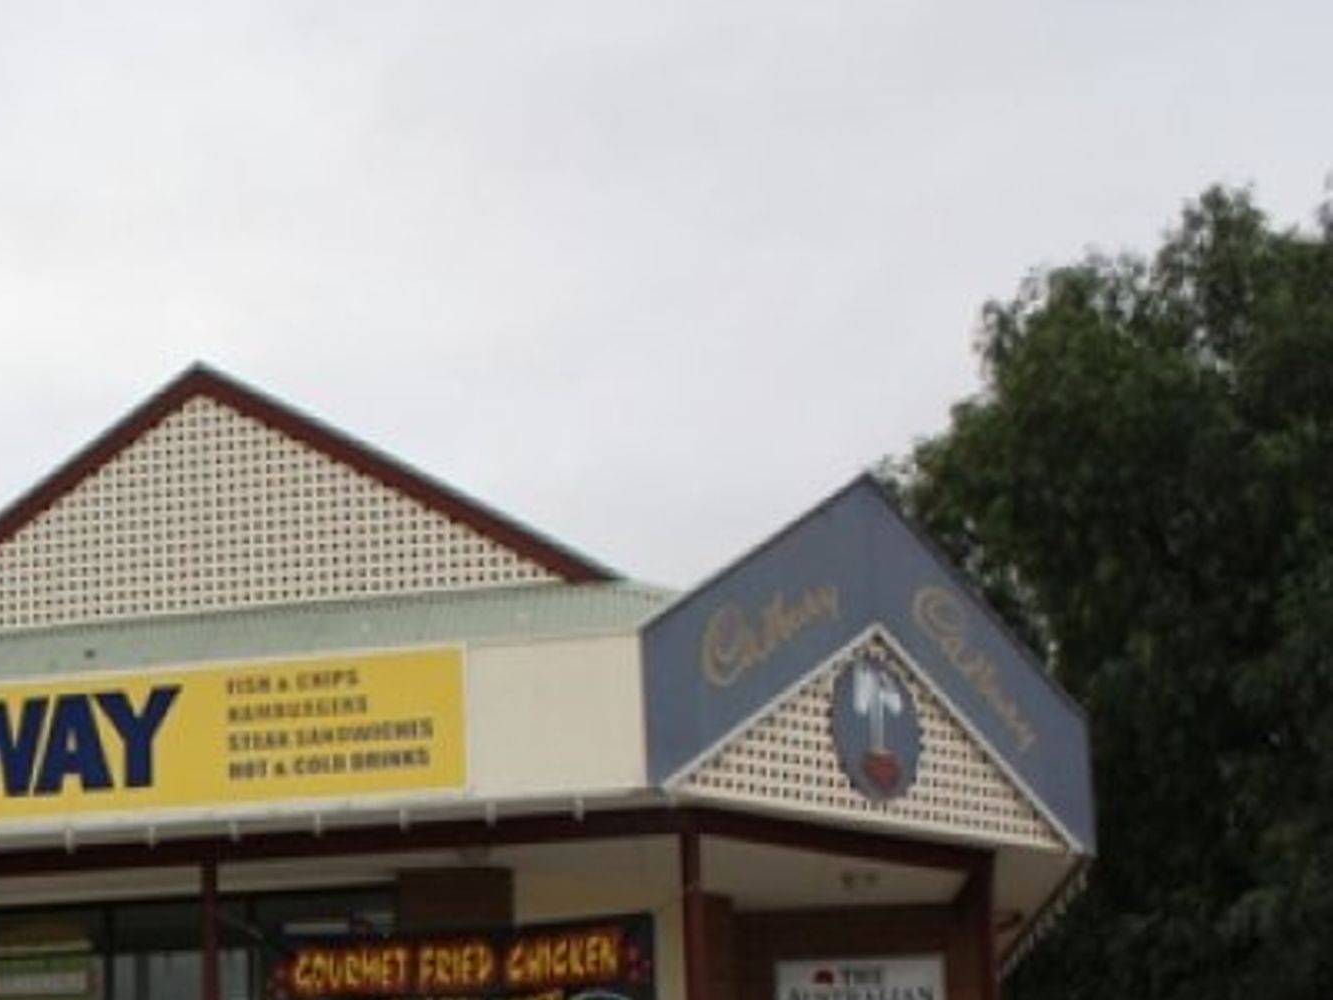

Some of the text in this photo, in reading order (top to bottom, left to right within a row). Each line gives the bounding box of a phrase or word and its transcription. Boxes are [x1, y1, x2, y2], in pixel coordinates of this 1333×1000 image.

[227, 677, 271, 695] FISH
[295, 668, 359, 692] CHIPS
[228, 696, 368, 722] HAMBURGERS
[229, 718, 434, 750] STEAK SANDWICHES
[229, 760, 268, 780] HOT
[293, 754, 347, 775] COLD
[350, 748, 430, 771] DRINKS
[292, 934, 622, 990] GOURMET FRIED CHICKEN
